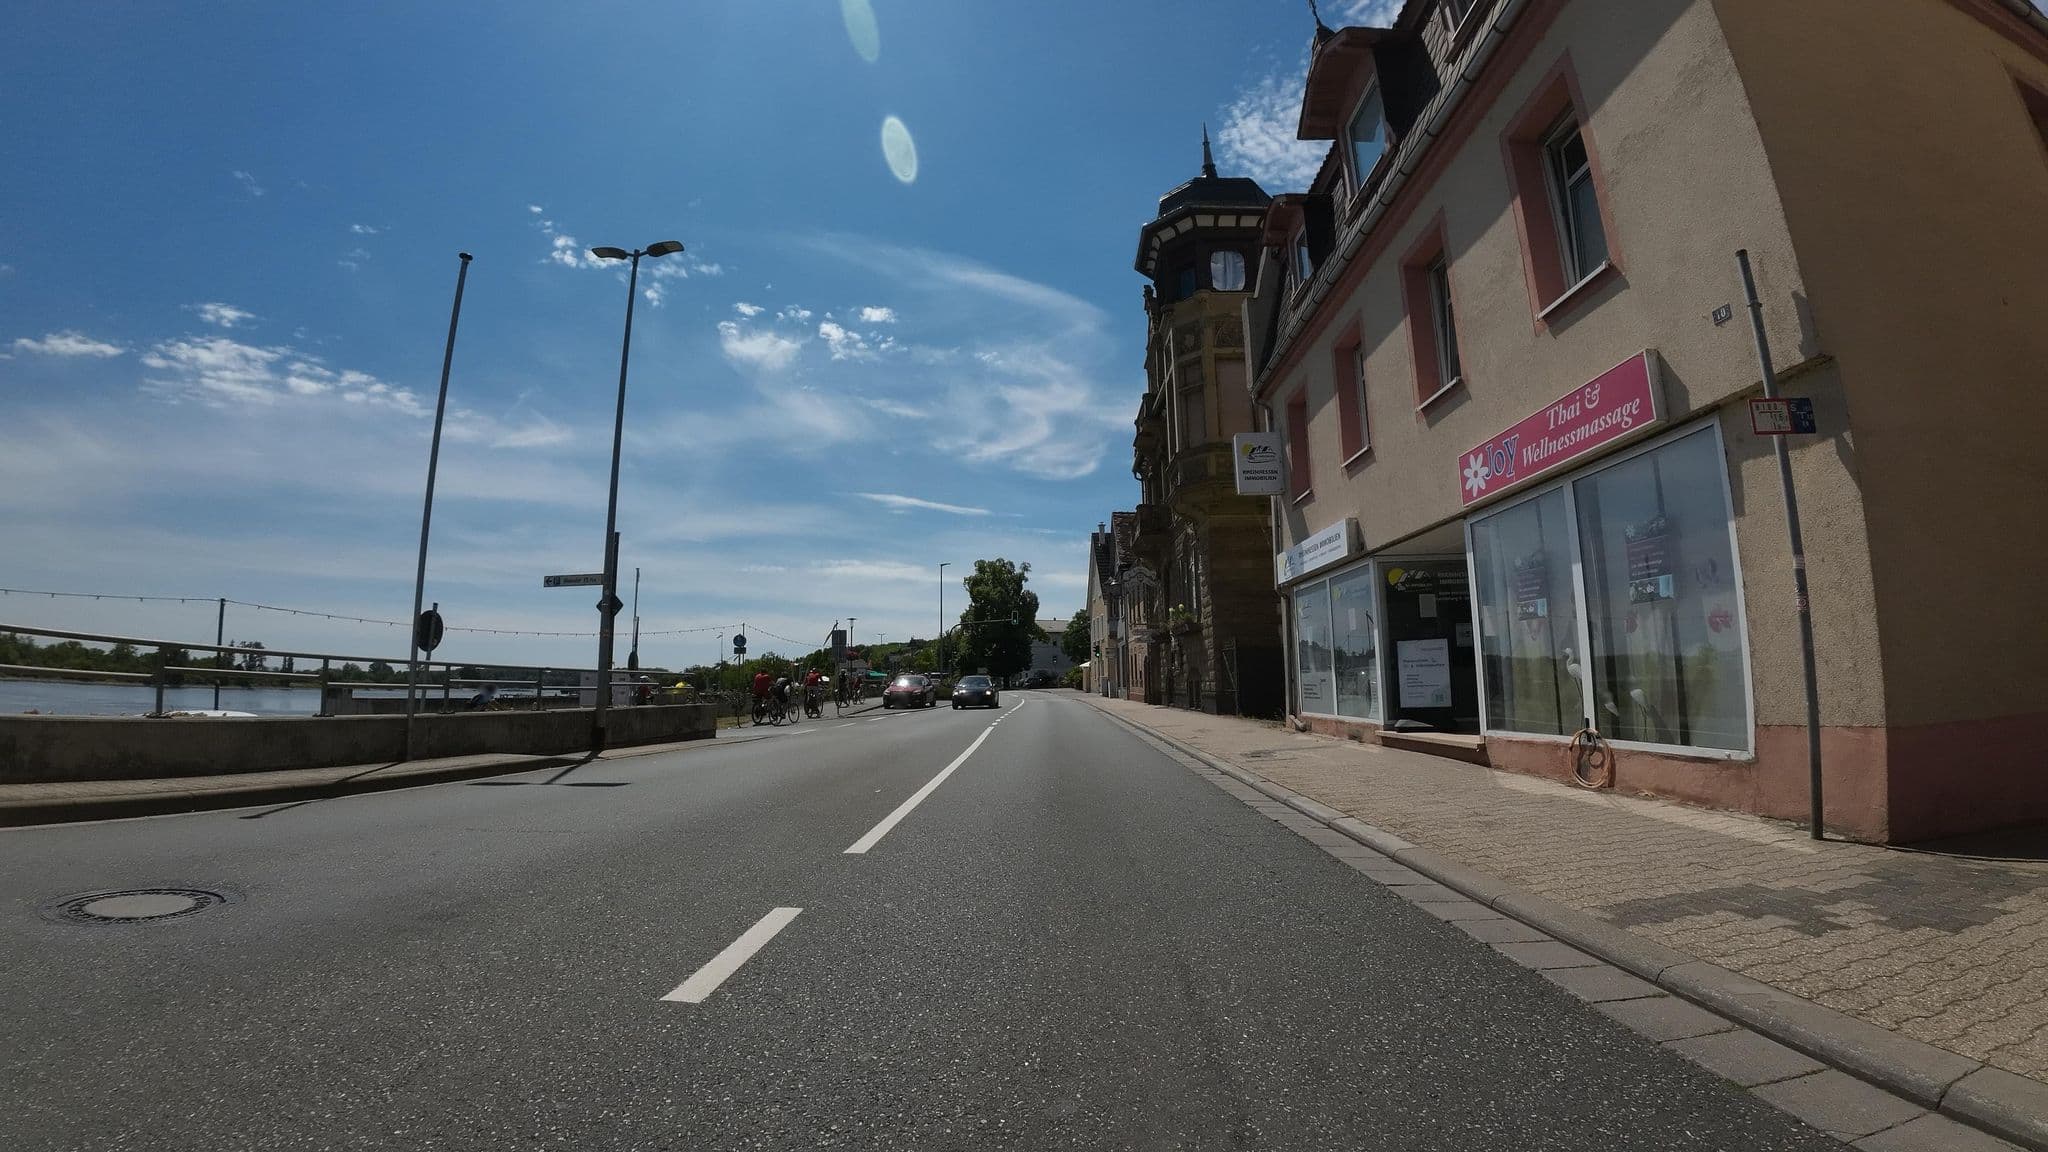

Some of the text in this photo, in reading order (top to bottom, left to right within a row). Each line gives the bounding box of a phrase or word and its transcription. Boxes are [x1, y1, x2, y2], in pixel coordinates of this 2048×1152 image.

[1522, 398, 1640, 468] Wellnessmassage
[1546, 383, 1601, 431] Thai &
